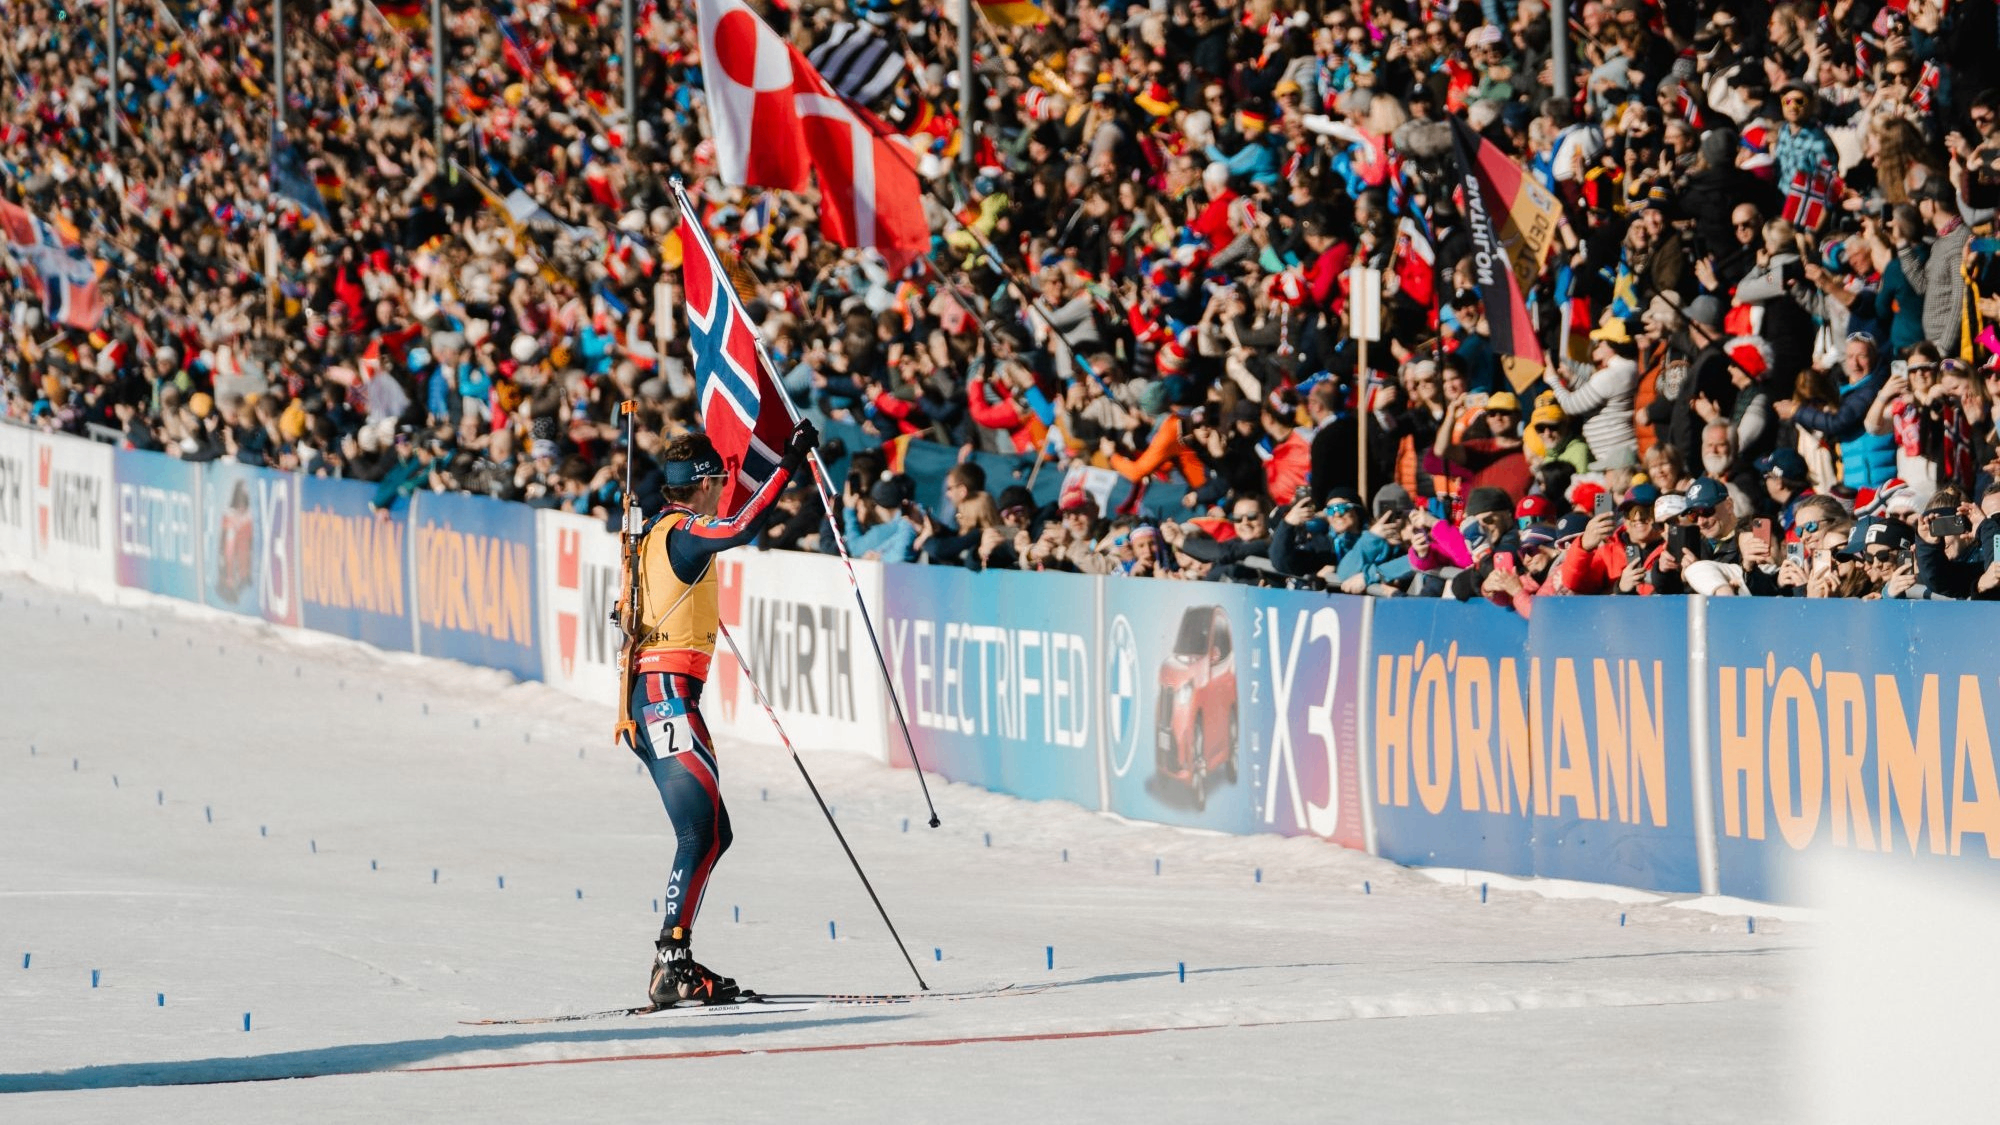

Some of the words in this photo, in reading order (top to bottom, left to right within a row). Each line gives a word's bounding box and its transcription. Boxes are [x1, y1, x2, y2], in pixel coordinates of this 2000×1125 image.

[693, 461, 710, 473] ice
[913, 618, 1091, 749] ELECTRIFIED
[1265, 606, 1341, 838] X3
[663, 721, 679, 753] 2
[1375, 640, 1668, 827] HÖRMANN
[665, 869, 683, 915] NOR
